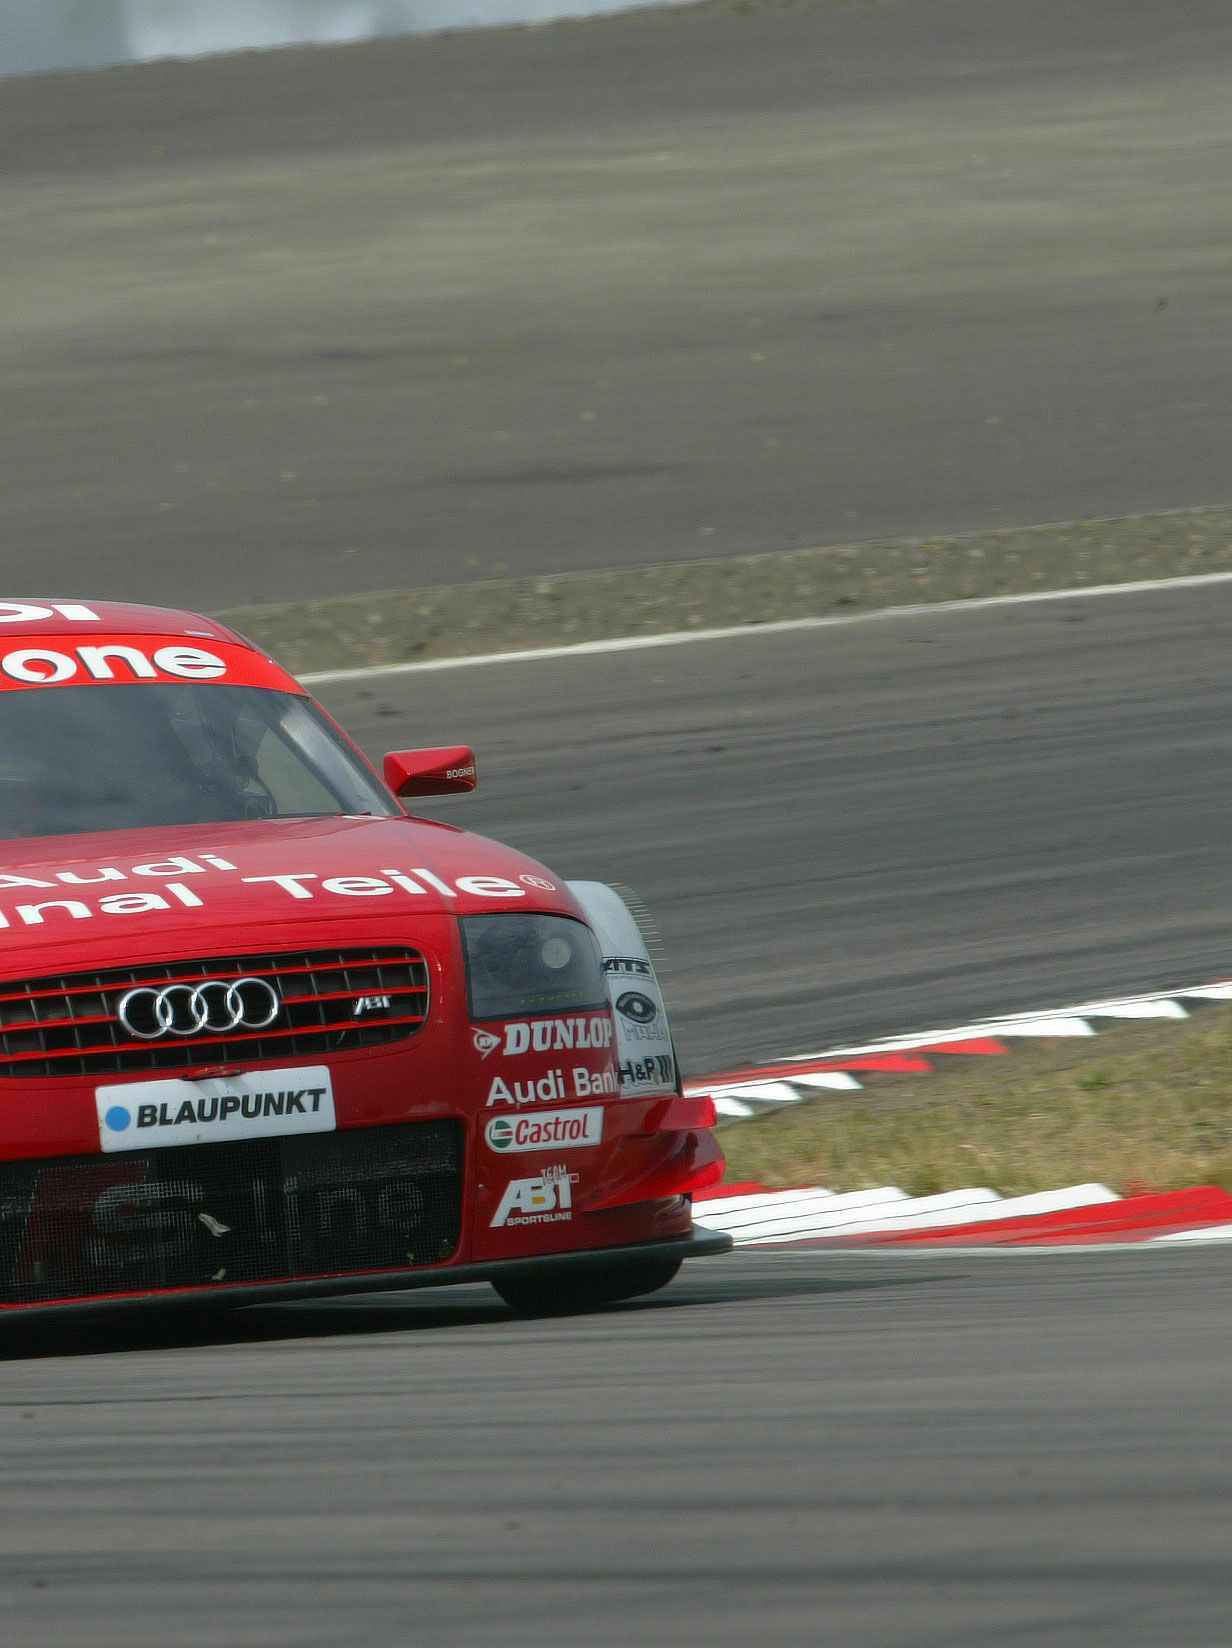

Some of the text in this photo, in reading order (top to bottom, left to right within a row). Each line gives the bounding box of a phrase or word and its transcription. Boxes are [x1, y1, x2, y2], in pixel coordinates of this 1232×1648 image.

[502, 1017, 613, 1056] DUNLOP
[485, 1070, 566, 1107] Audi
[136, 1088, 327, 1129] BLAUPUNKT
[515, 1113, 590, 1145] Castrol
[490, 1174, 572, 1228] ABT
